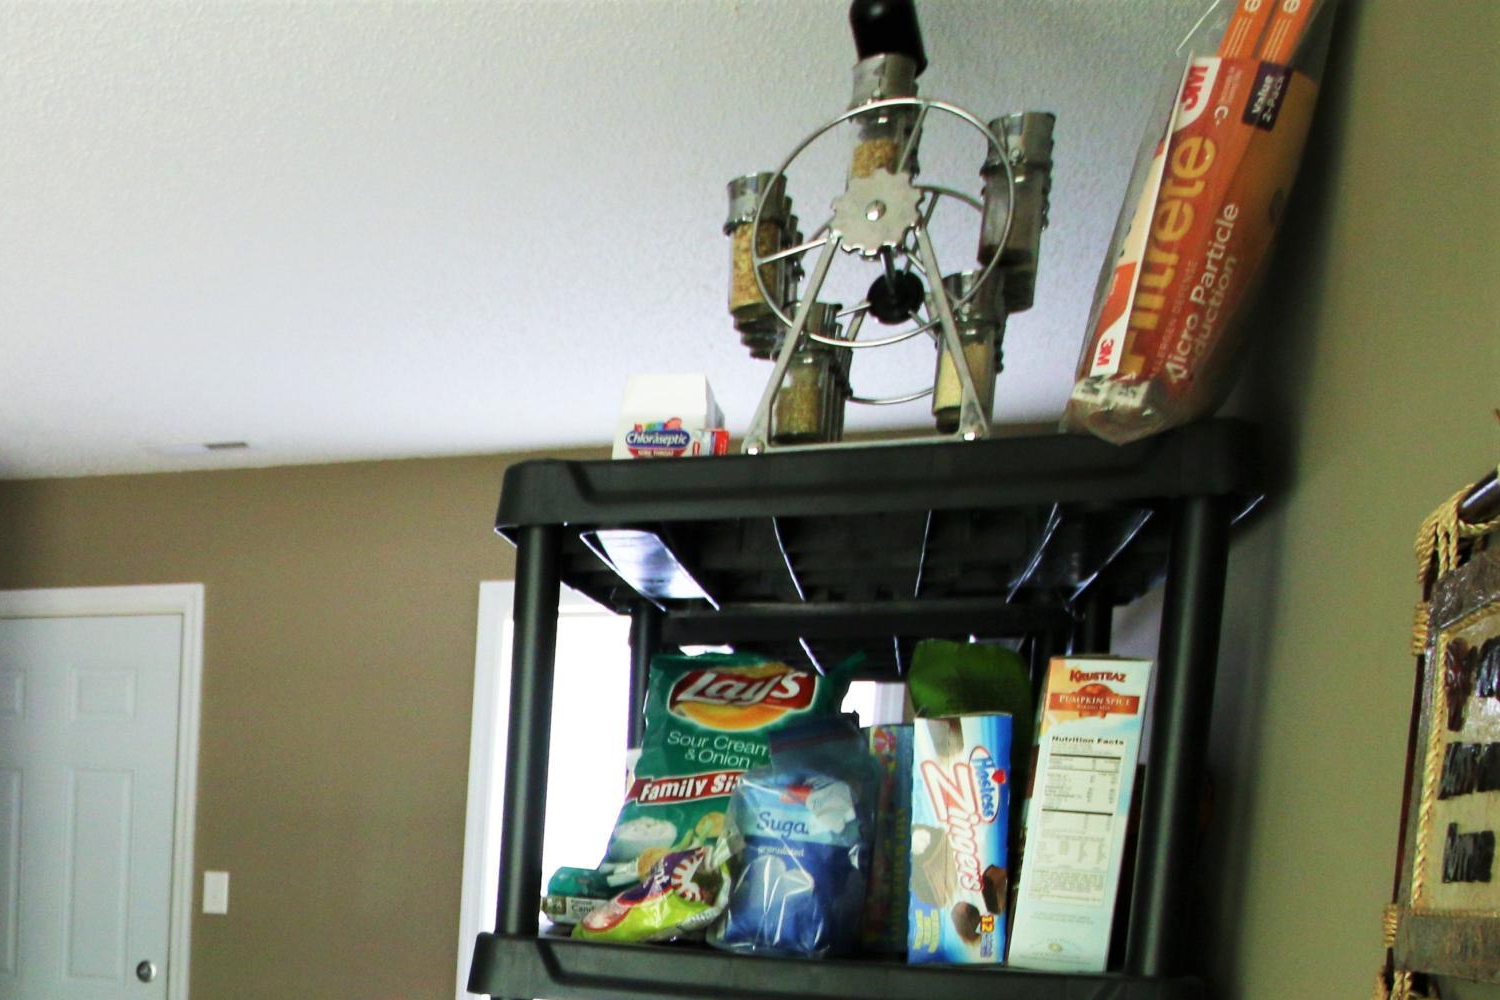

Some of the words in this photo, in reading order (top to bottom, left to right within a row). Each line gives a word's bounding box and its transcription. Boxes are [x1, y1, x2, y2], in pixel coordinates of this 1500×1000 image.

[1181, 66, 1208, 111] 3M
[1251, 75, 1272, 114] Value
[1190, 203, 1239, 305] Particle
[1195, 255, 1237, 358] duction
[1096, 338, 1115, 366] 3M
[626, 432, 688, 447] Chloraseptic
[667, 731, 709, 748] Sour
[698, 748, 750, 768] Onion
[639, 777, 708, 801] Family
[974, 756, 994, 818] Hostess
[756, 812, 810, 840] Suga
[921, 760, 985, 892] Zingers
[980, 914, 994, 934] 12
